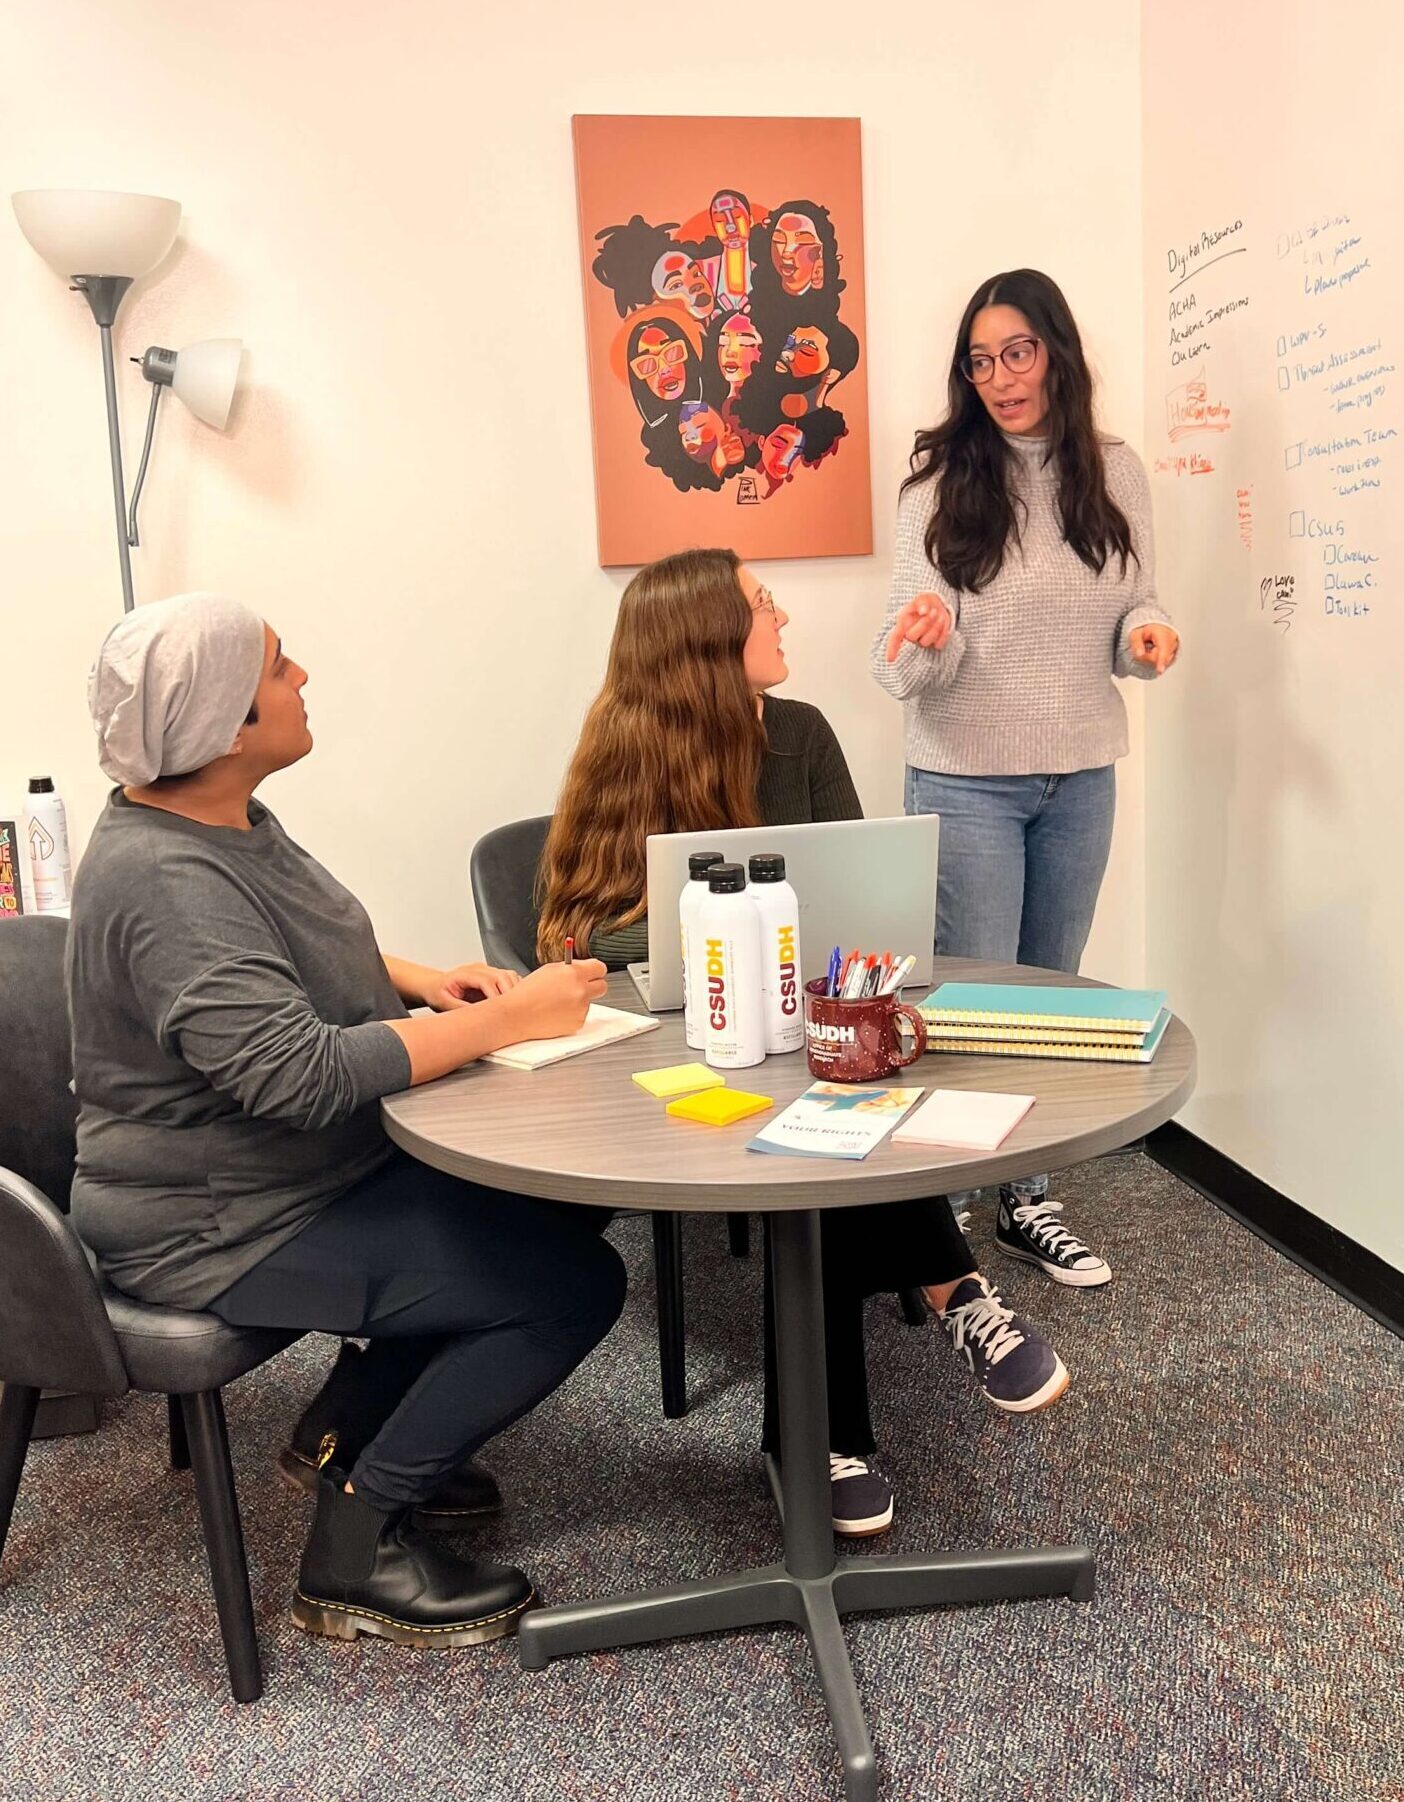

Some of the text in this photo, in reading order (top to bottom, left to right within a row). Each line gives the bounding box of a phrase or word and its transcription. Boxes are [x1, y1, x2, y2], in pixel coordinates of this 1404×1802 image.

[1167, 243, 1200, 279] Digital
[1201, 219, 1243, 250] Resources
[1168, 293, 1197, 321] ACHA
[1274, 575, 1295, 587] Love
[706, 939, 726, 1030] CSUDH
[778, 925, 797, 1016] CSUDH
